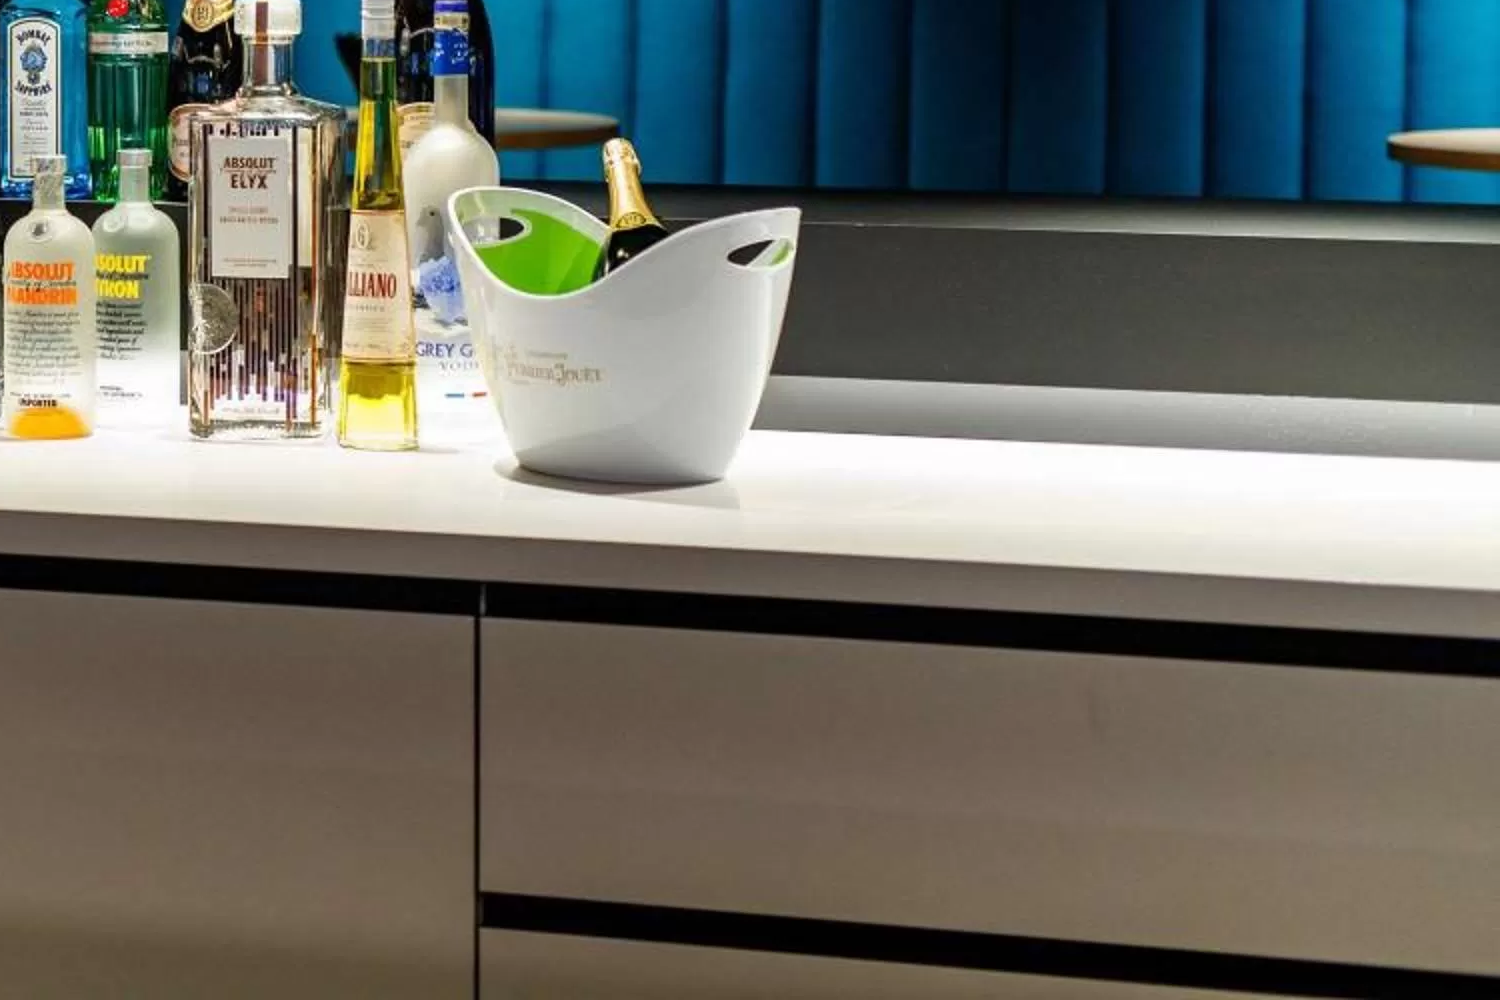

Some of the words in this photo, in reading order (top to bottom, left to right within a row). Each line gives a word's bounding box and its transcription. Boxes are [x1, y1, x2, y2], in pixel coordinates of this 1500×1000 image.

[224, 157, 276, 168] ABSOLUT
[231, 174, 268, 189] ELYX
[415, 342, 455, 358] GREY
